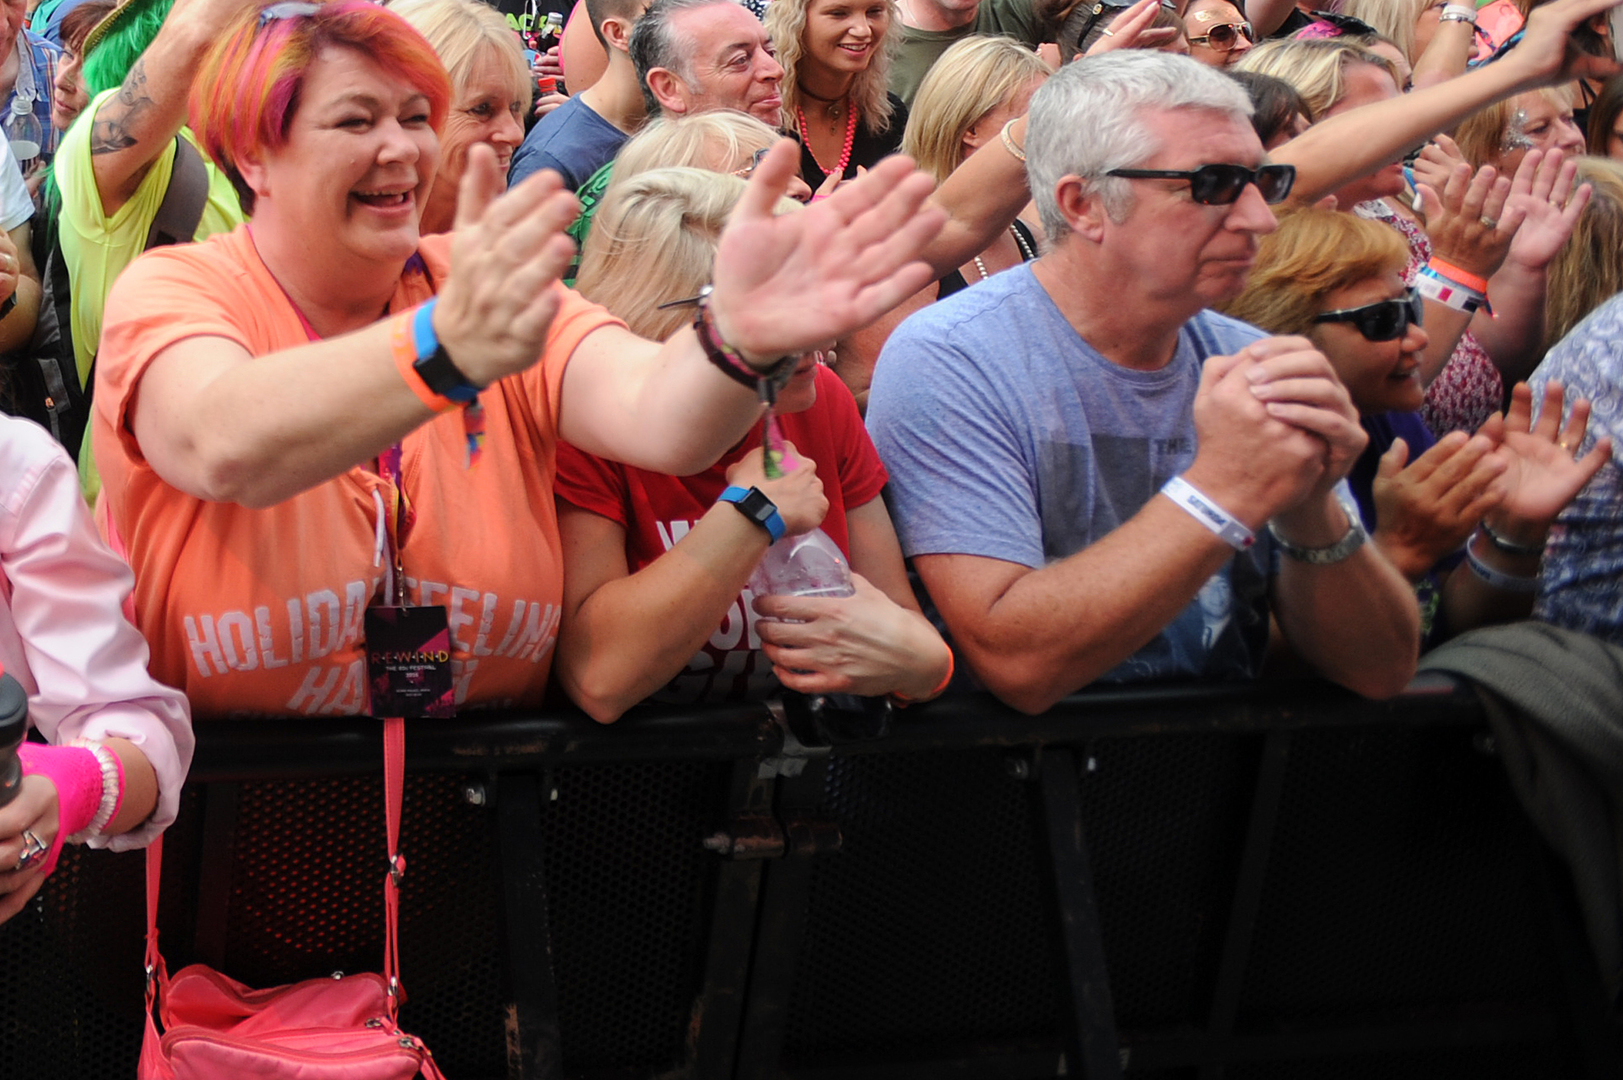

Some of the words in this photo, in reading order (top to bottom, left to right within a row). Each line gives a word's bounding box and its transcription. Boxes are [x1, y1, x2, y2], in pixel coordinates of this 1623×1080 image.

[183, 578, 380, 677] HOLIDA
[405, 576, 562, 663] ELING
[371, 649, 449, 664] REWIND
